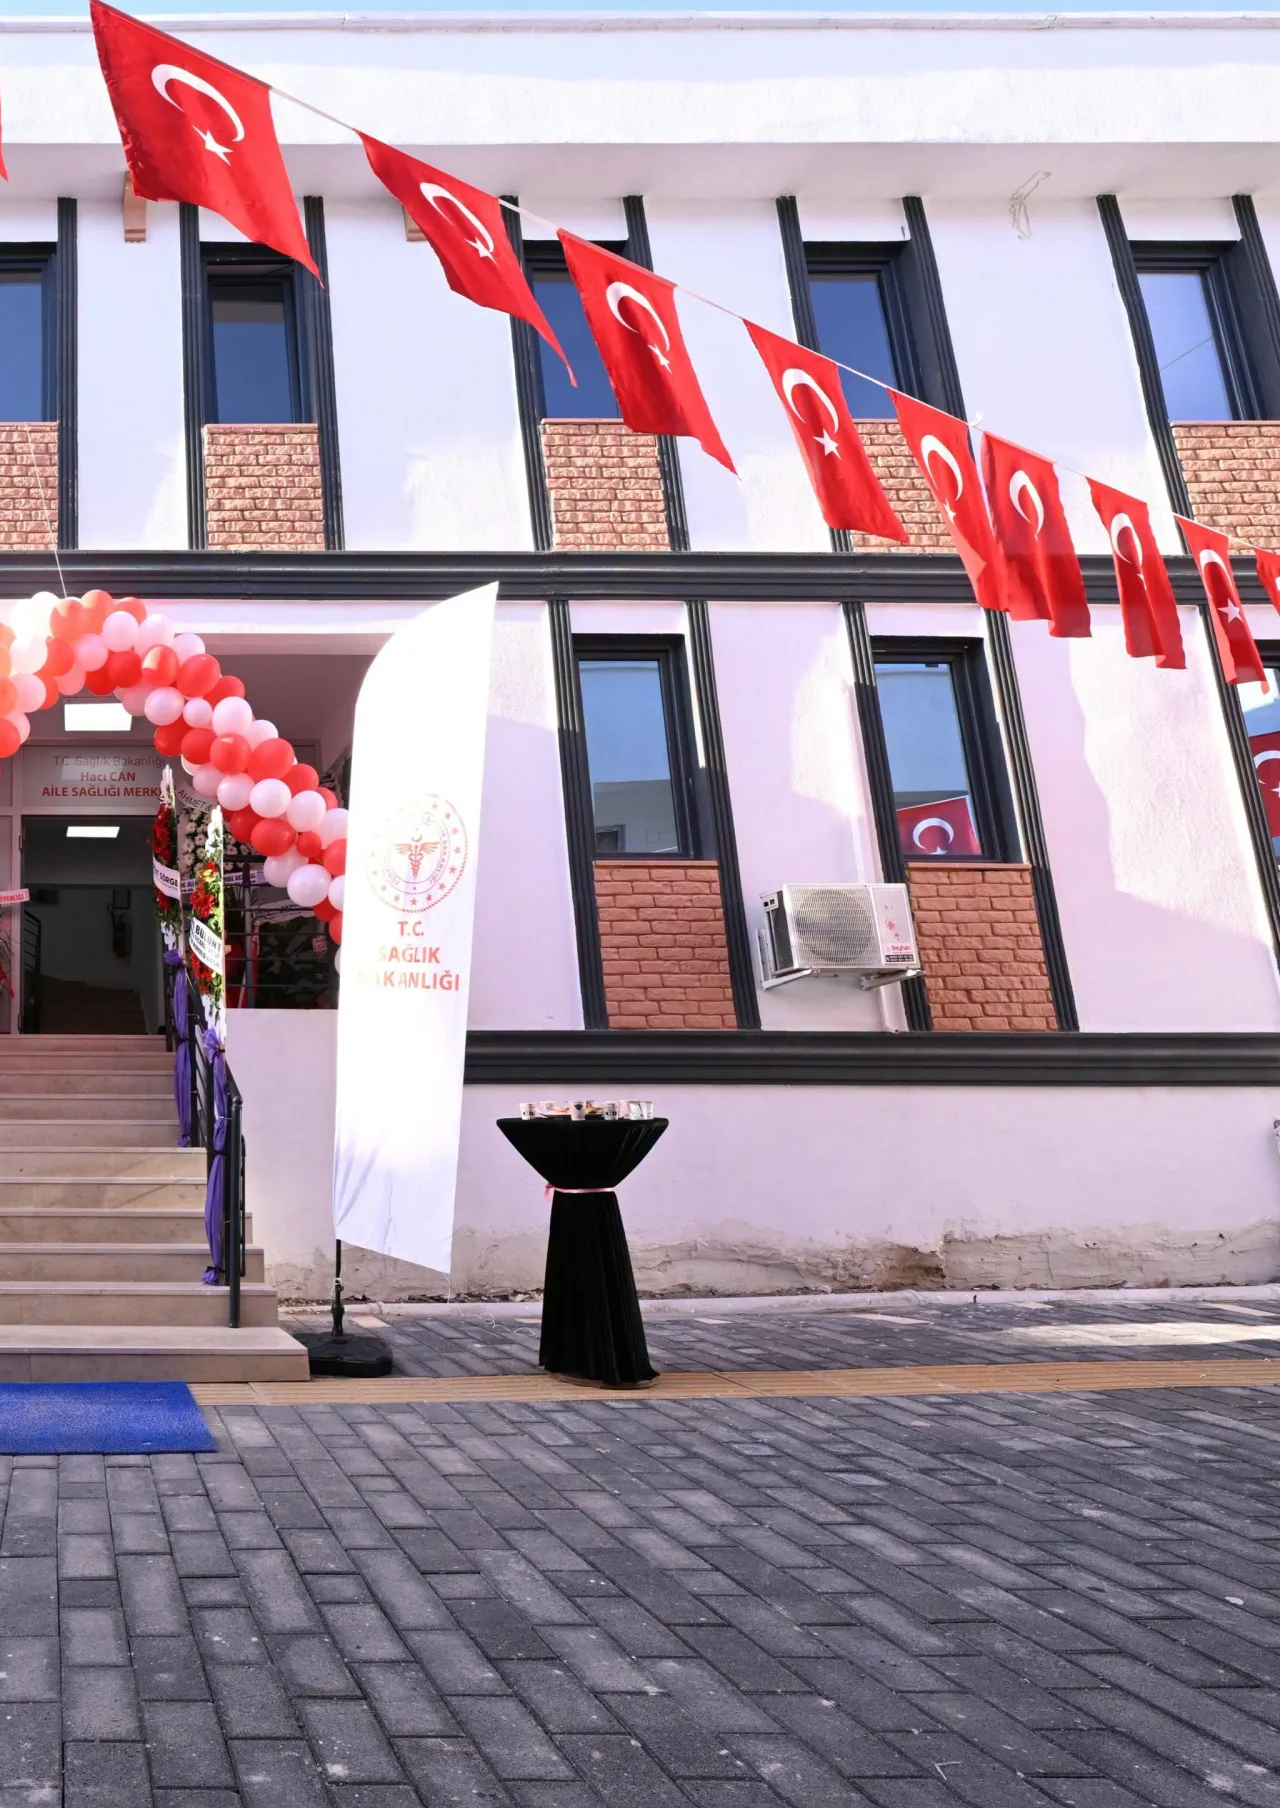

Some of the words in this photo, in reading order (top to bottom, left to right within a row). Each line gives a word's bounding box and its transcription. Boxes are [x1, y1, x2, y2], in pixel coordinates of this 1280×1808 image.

[75, 755, 109, 767] Sağlık
[113, 755, 165, 767] Bakanlığı
[80, 771, 107, 782] Hacı
[109, 771, 136, 782] CAN
[41, 784, 69, 797] AİLE
[71, 784, 121, 797] SAĞLIĞI
[177, 789, 207, 809] AHMET
[397, 920, 425, 937] T.C.
[377, 944, 441, 965] SAĞLIK
